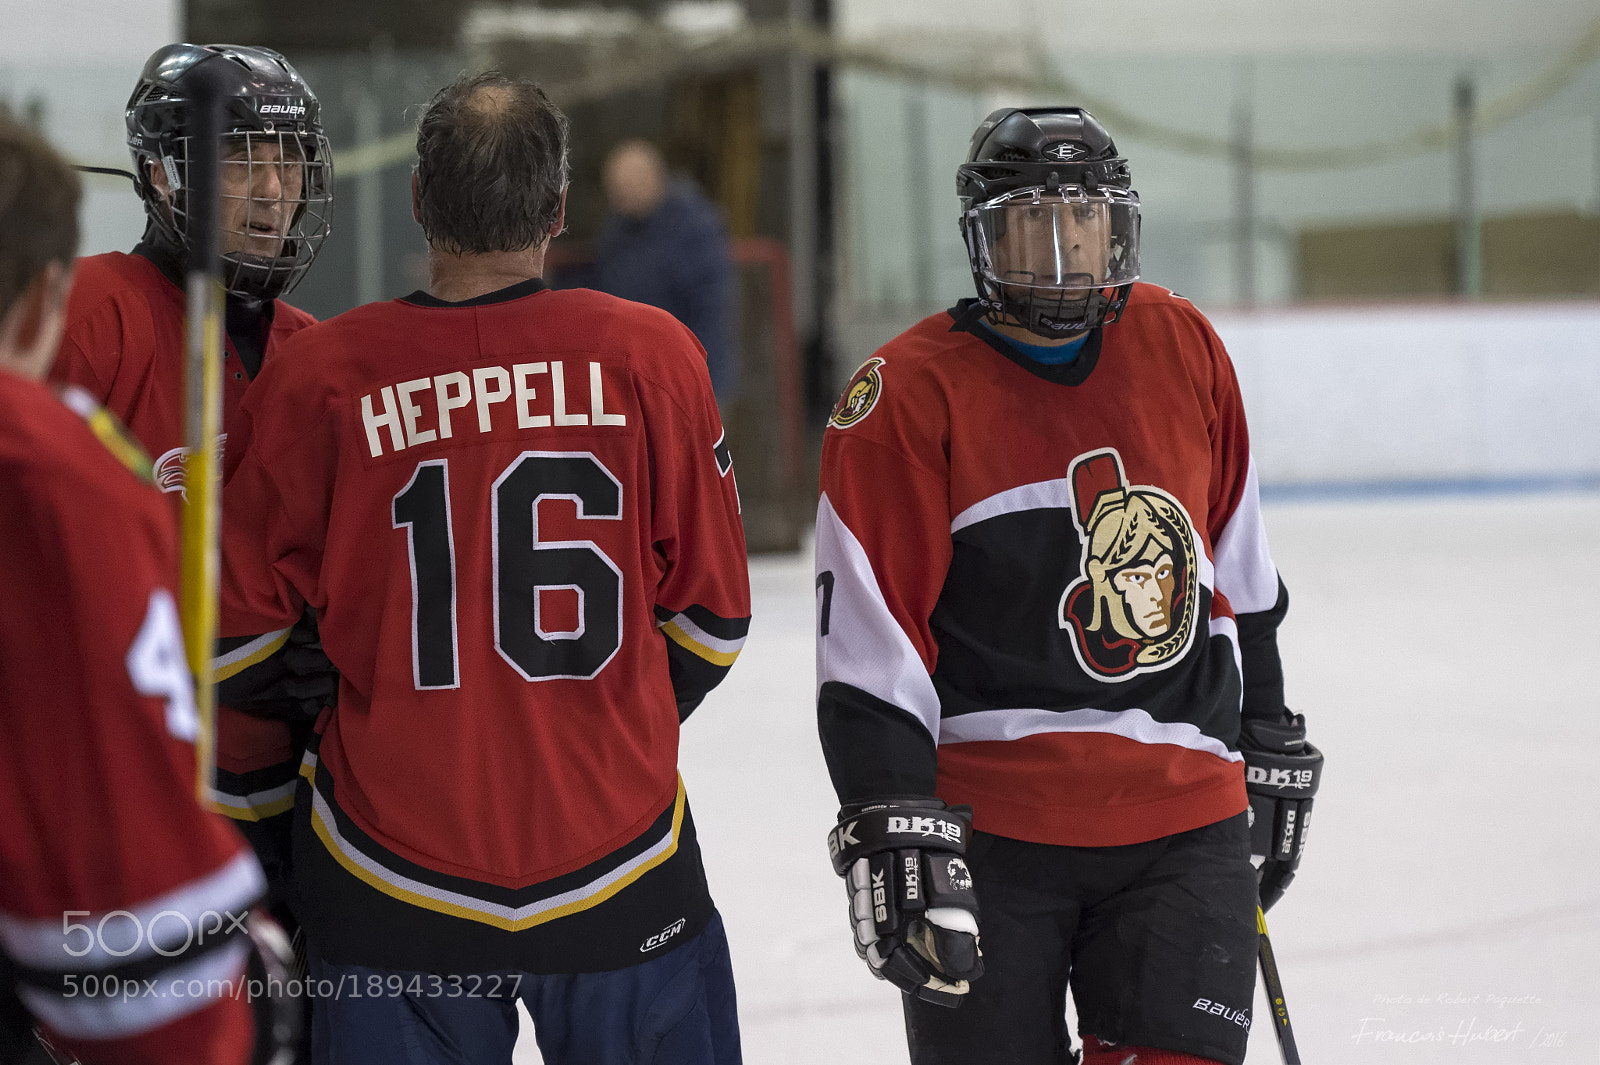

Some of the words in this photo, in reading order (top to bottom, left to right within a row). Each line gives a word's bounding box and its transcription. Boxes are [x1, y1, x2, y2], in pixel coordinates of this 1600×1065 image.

[360, 360, 627, 458] HEPPELL
[391, 450, 624, 691] 16
[871, 868, 888, 923] SBK
[646, 923, 682, 947] CCM
